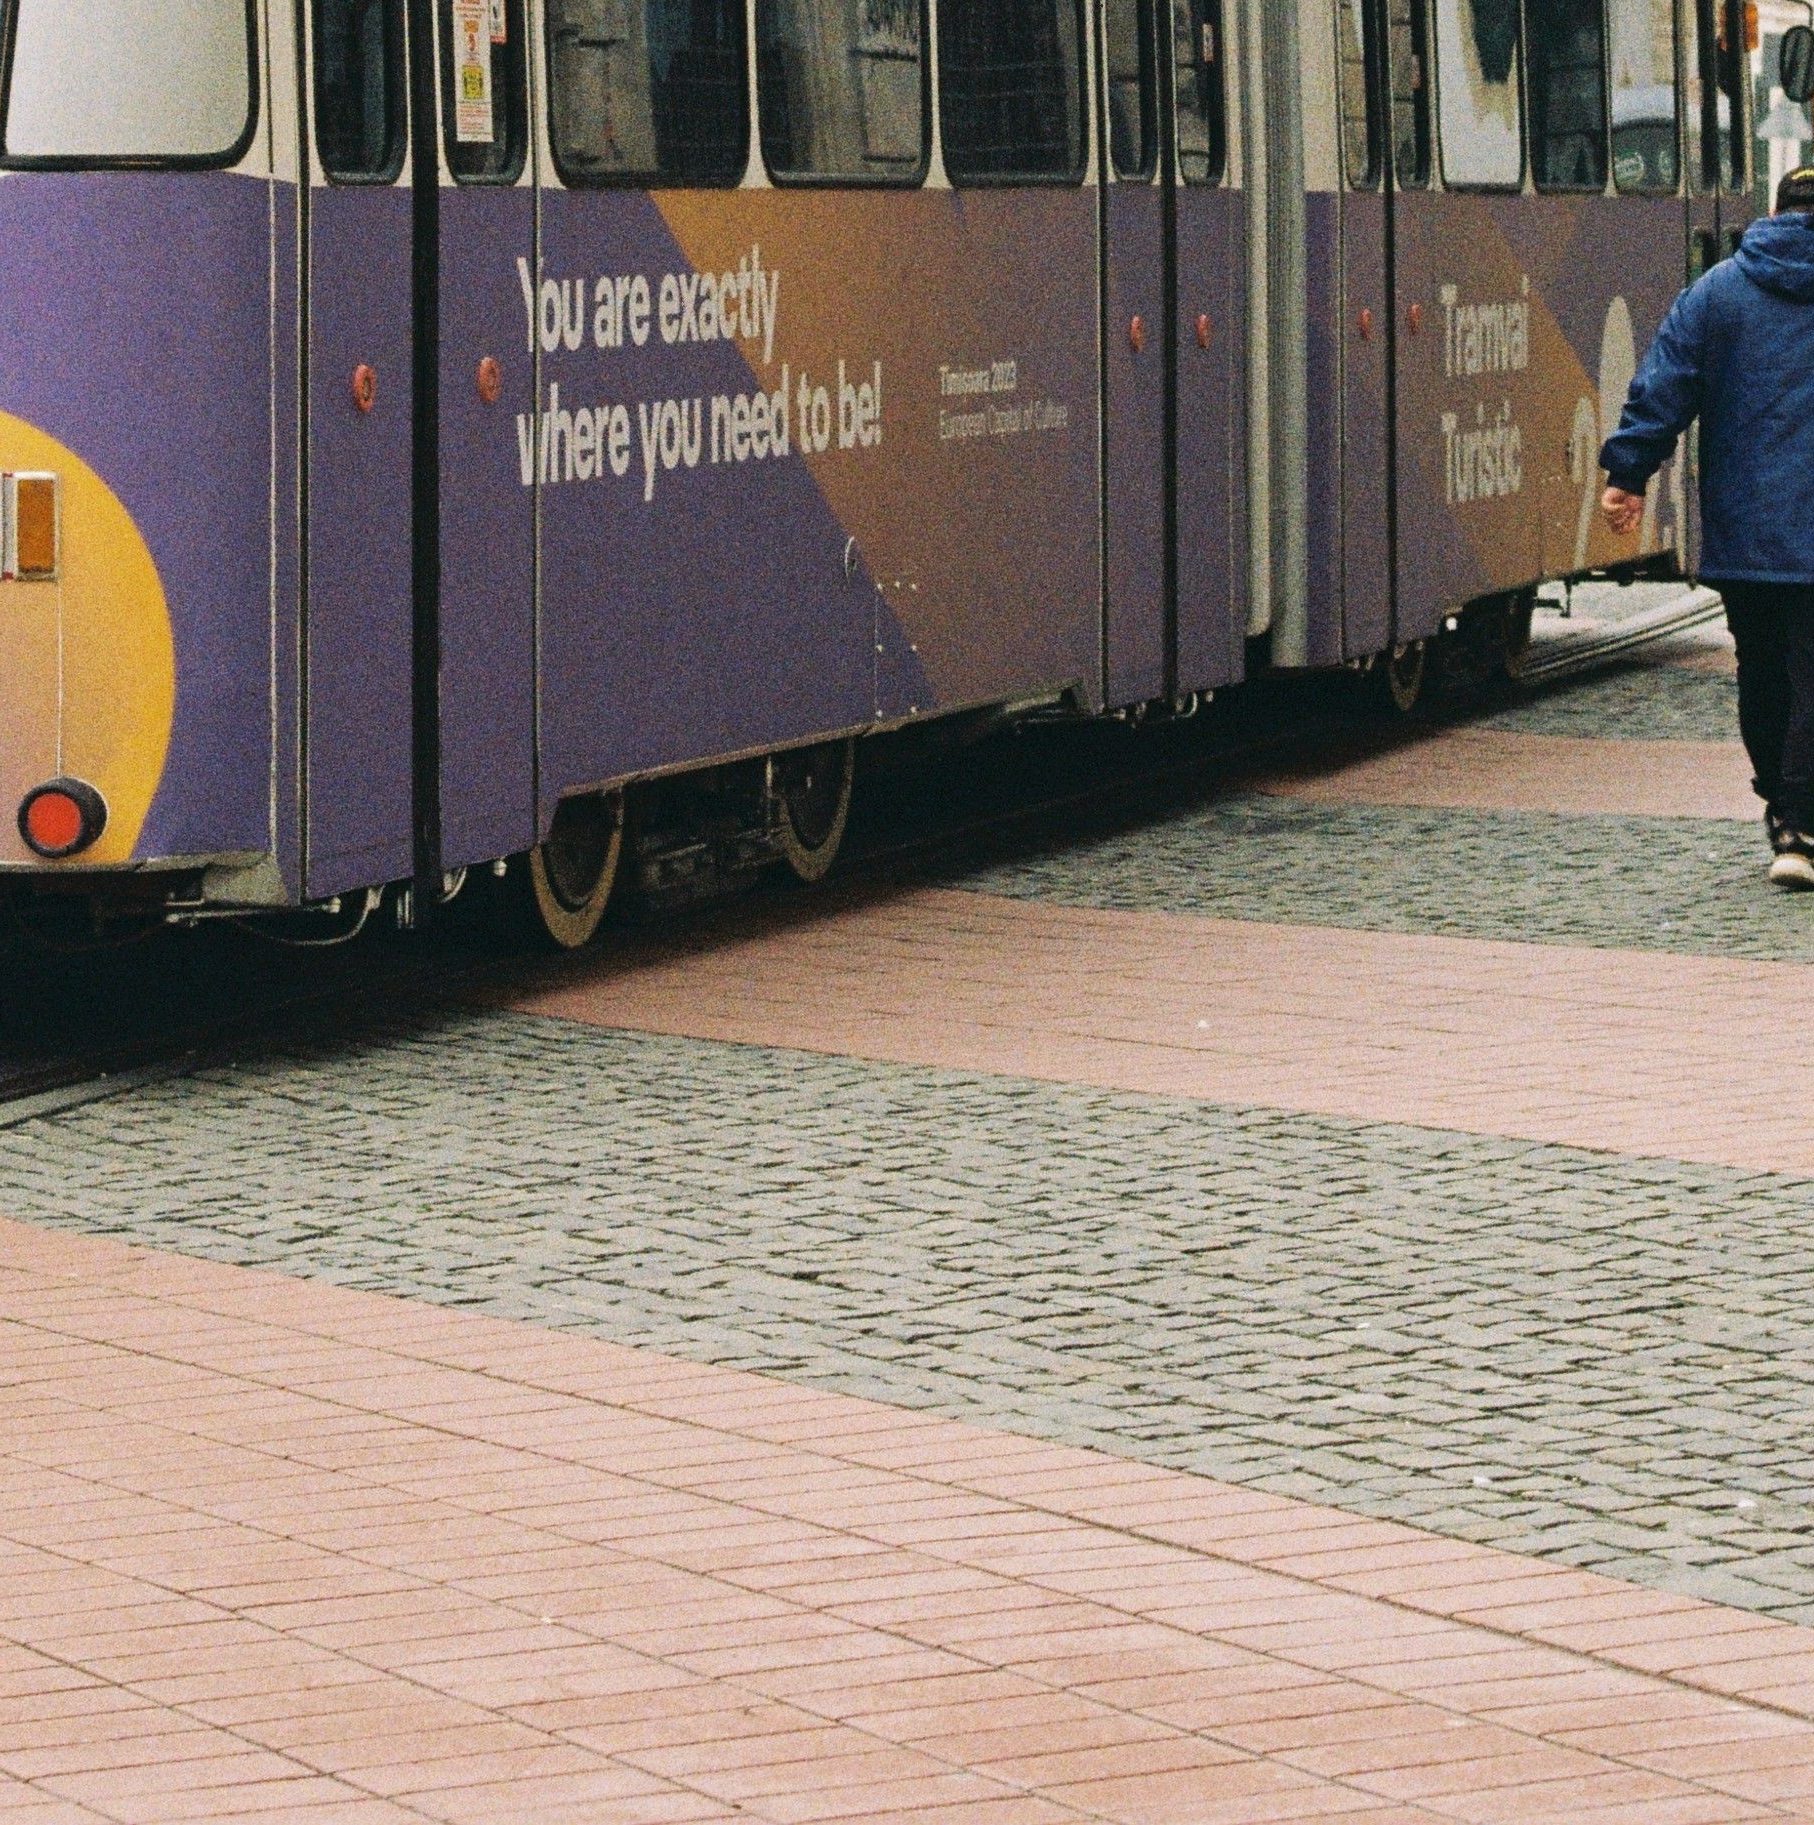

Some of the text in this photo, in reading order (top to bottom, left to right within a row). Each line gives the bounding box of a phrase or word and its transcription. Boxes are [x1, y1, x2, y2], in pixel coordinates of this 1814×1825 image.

[517, 242, 779, 365] You are exactly
[1440, 275, 1529, 377] Tramvai
[516, 359, 883, 502] where you need to be!
[1440, 399, 1522, 505] Turistic
